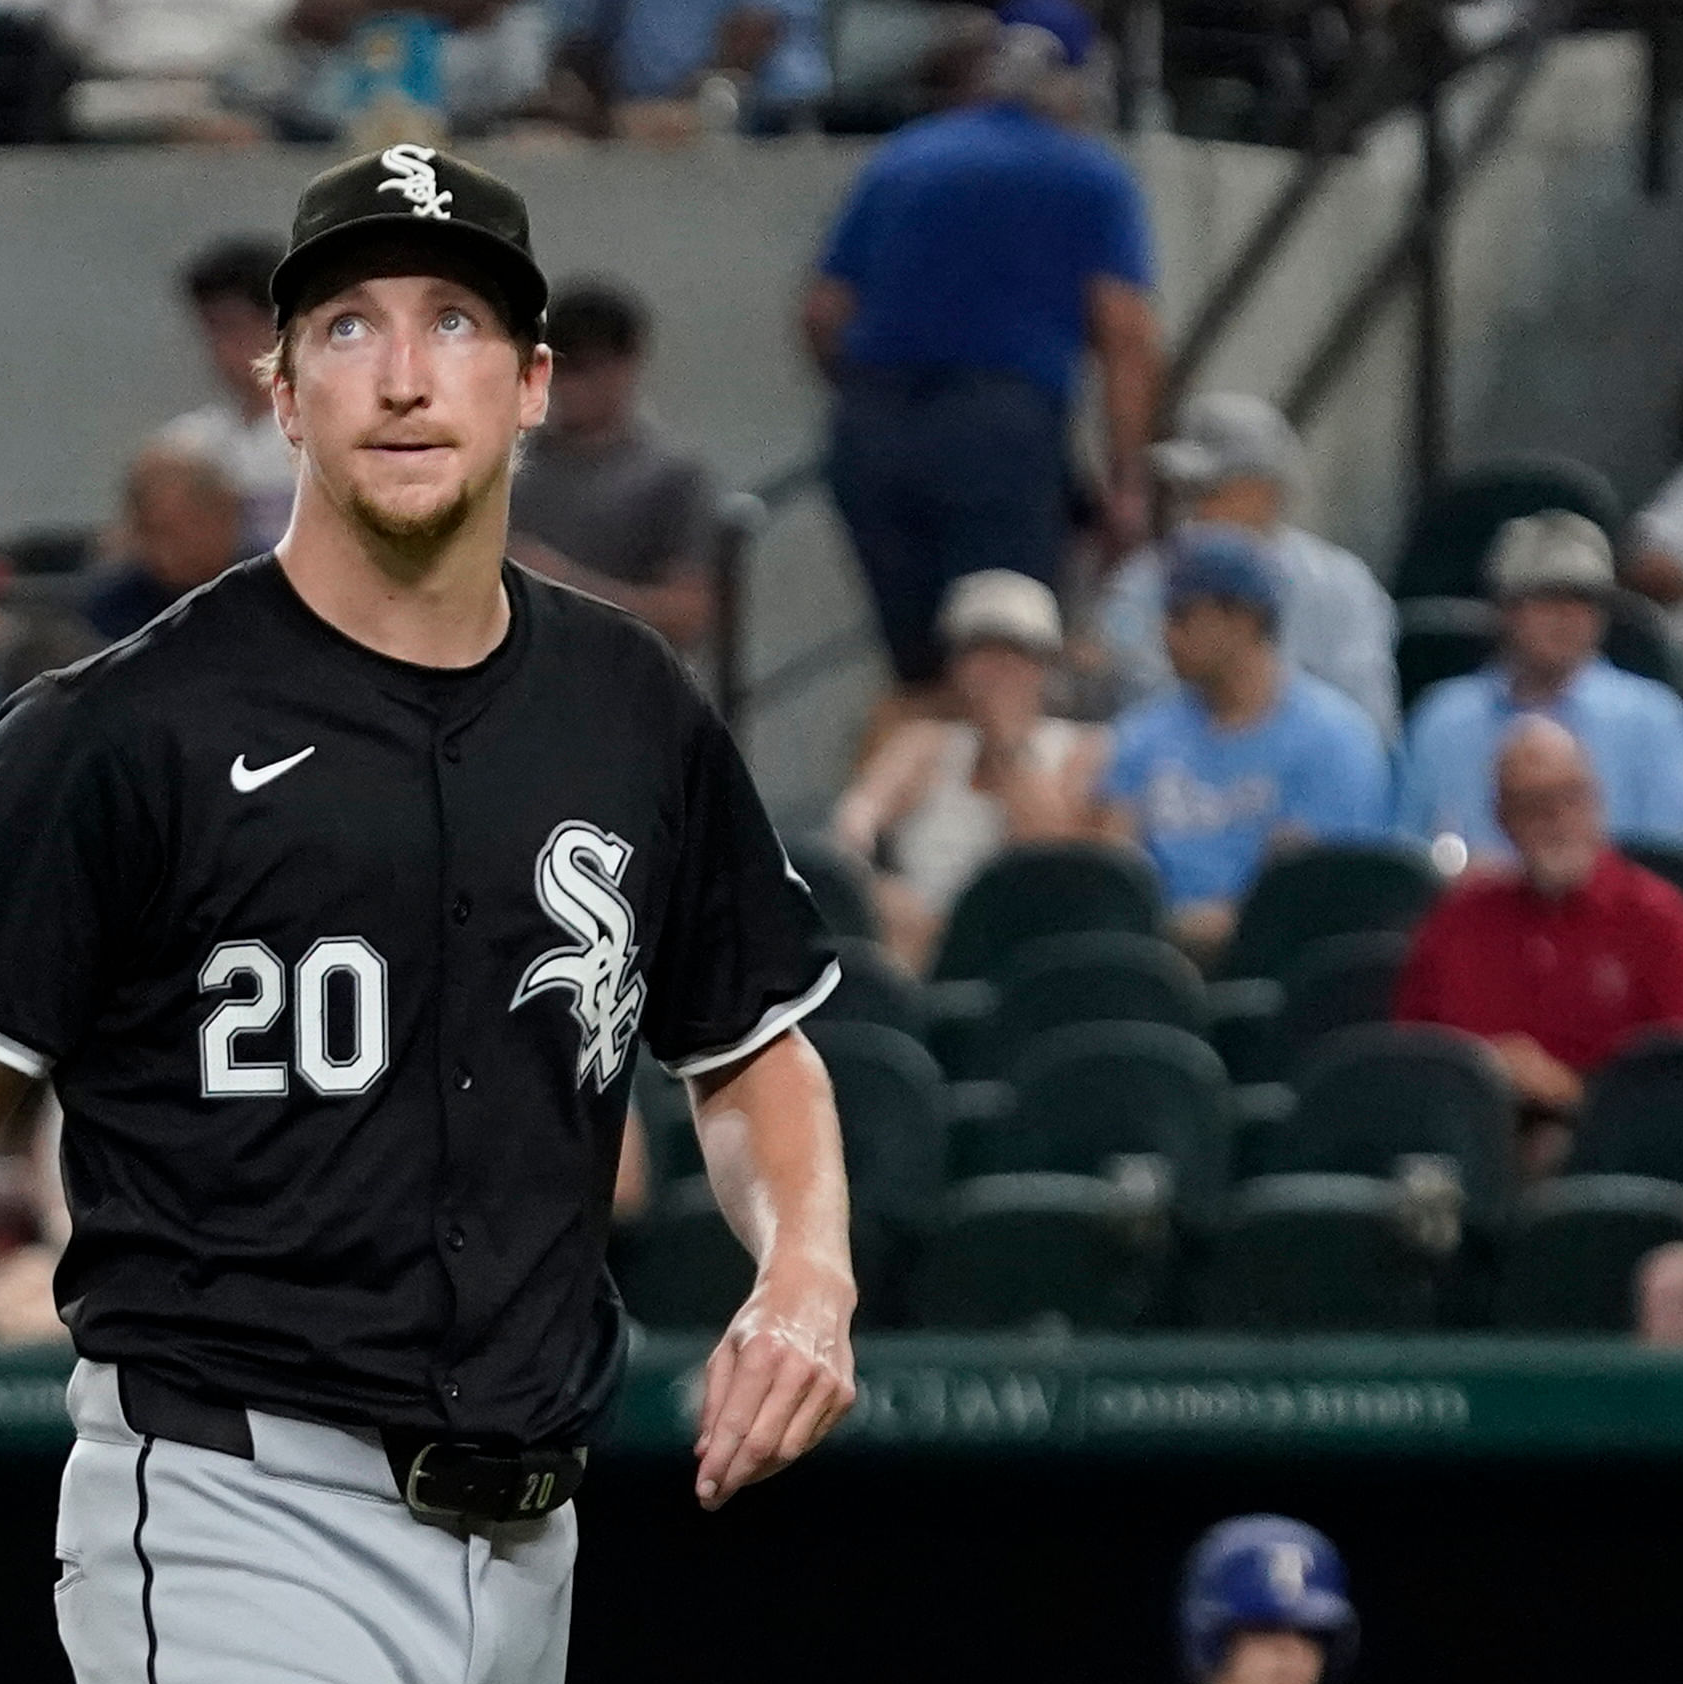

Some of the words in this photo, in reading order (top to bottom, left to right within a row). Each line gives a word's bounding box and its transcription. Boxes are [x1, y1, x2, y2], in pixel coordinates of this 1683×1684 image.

[197, 934, 390, 1098] 20
[509, 818, 648, 1094] Sox
[518, 1471, 555, 1511] 20
